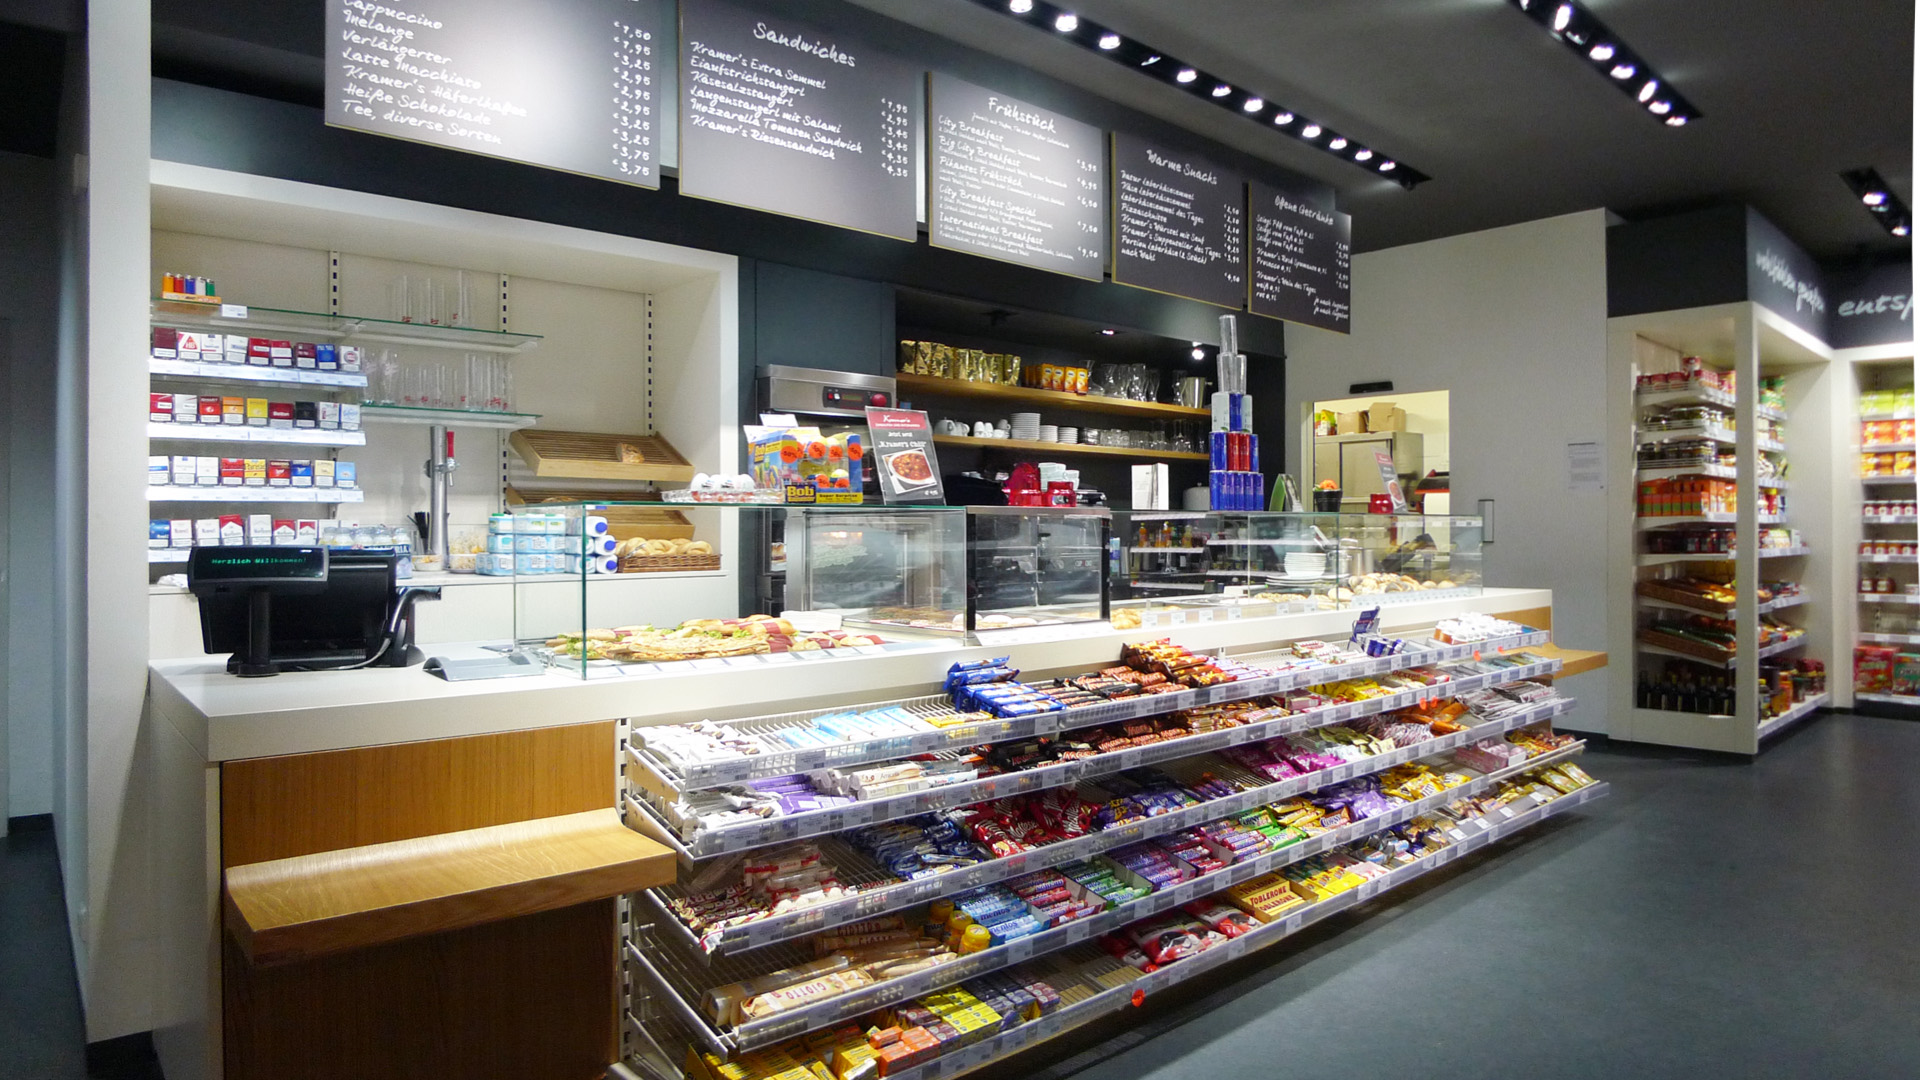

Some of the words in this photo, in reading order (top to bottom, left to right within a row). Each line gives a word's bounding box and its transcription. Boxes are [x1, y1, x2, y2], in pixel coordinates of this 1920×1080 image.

[343, 9, 414, 44] Melange
[343, 30, 452, 64] Verlängerter
[752, 22, 856, 67] Sandwiches
[343, 47, 390, 68] Latte
[394, 53, 481, 89] Macchiato
[343, 65, 425, 93] Kramer's
[690, 41, 748, 66] Kramer's
[750, 58, 783, 77] Extra
[785, 69, 826, 89] Semmel
[343, 82, 393, 104] Heiße
[398, 95, 491, 125] Schokolade
[690, 85, 780, 121] Laugenstangerl
[782, 112, 801, 123] mit
[802, 115, 841, 133] Salami
[988, 96, 1056, 133] Frühstück
[342, 100, 376, 120] Tee,
[384, 110, 443, 131] diverse
[447, 123, 502, 144] Sorten
[690, 98, 760, 126] Mozzarella
[763, 118, 811, 139] Tomaten
[812, 131, 863, 153] Sandwich
[690, 115, 748, 137] Kramer's
[750, 129, 836, 160] Riesensandwich
[939, 115, 956, 130] City
[958, 121, 1004, 142] Breakfast
[939, 135, 956, 151] Big
[957, 141, 975, 156] City
[976, 146, 1021, 167] Breakfast
[1146, 149, 1182, 173] Warme
[1183, 163, 1217, 185] Snacks
[939, 156, 978, 174] Pikantes
[979, 167, 1023, 187] Frühstück
[939, 184, 957, 199] City
[958, 189, 1005, 209] Breakfast
[1005, 201, 1036, 217] Special
[939, 211, 1000, 234] International
[1001, 227, 1044, 245] Breakfast
[787, 486, 814, 497] Bob
[1250, 886, 1287, 906] TOBLERONE
[980, 908, 1010, 920] mentos
